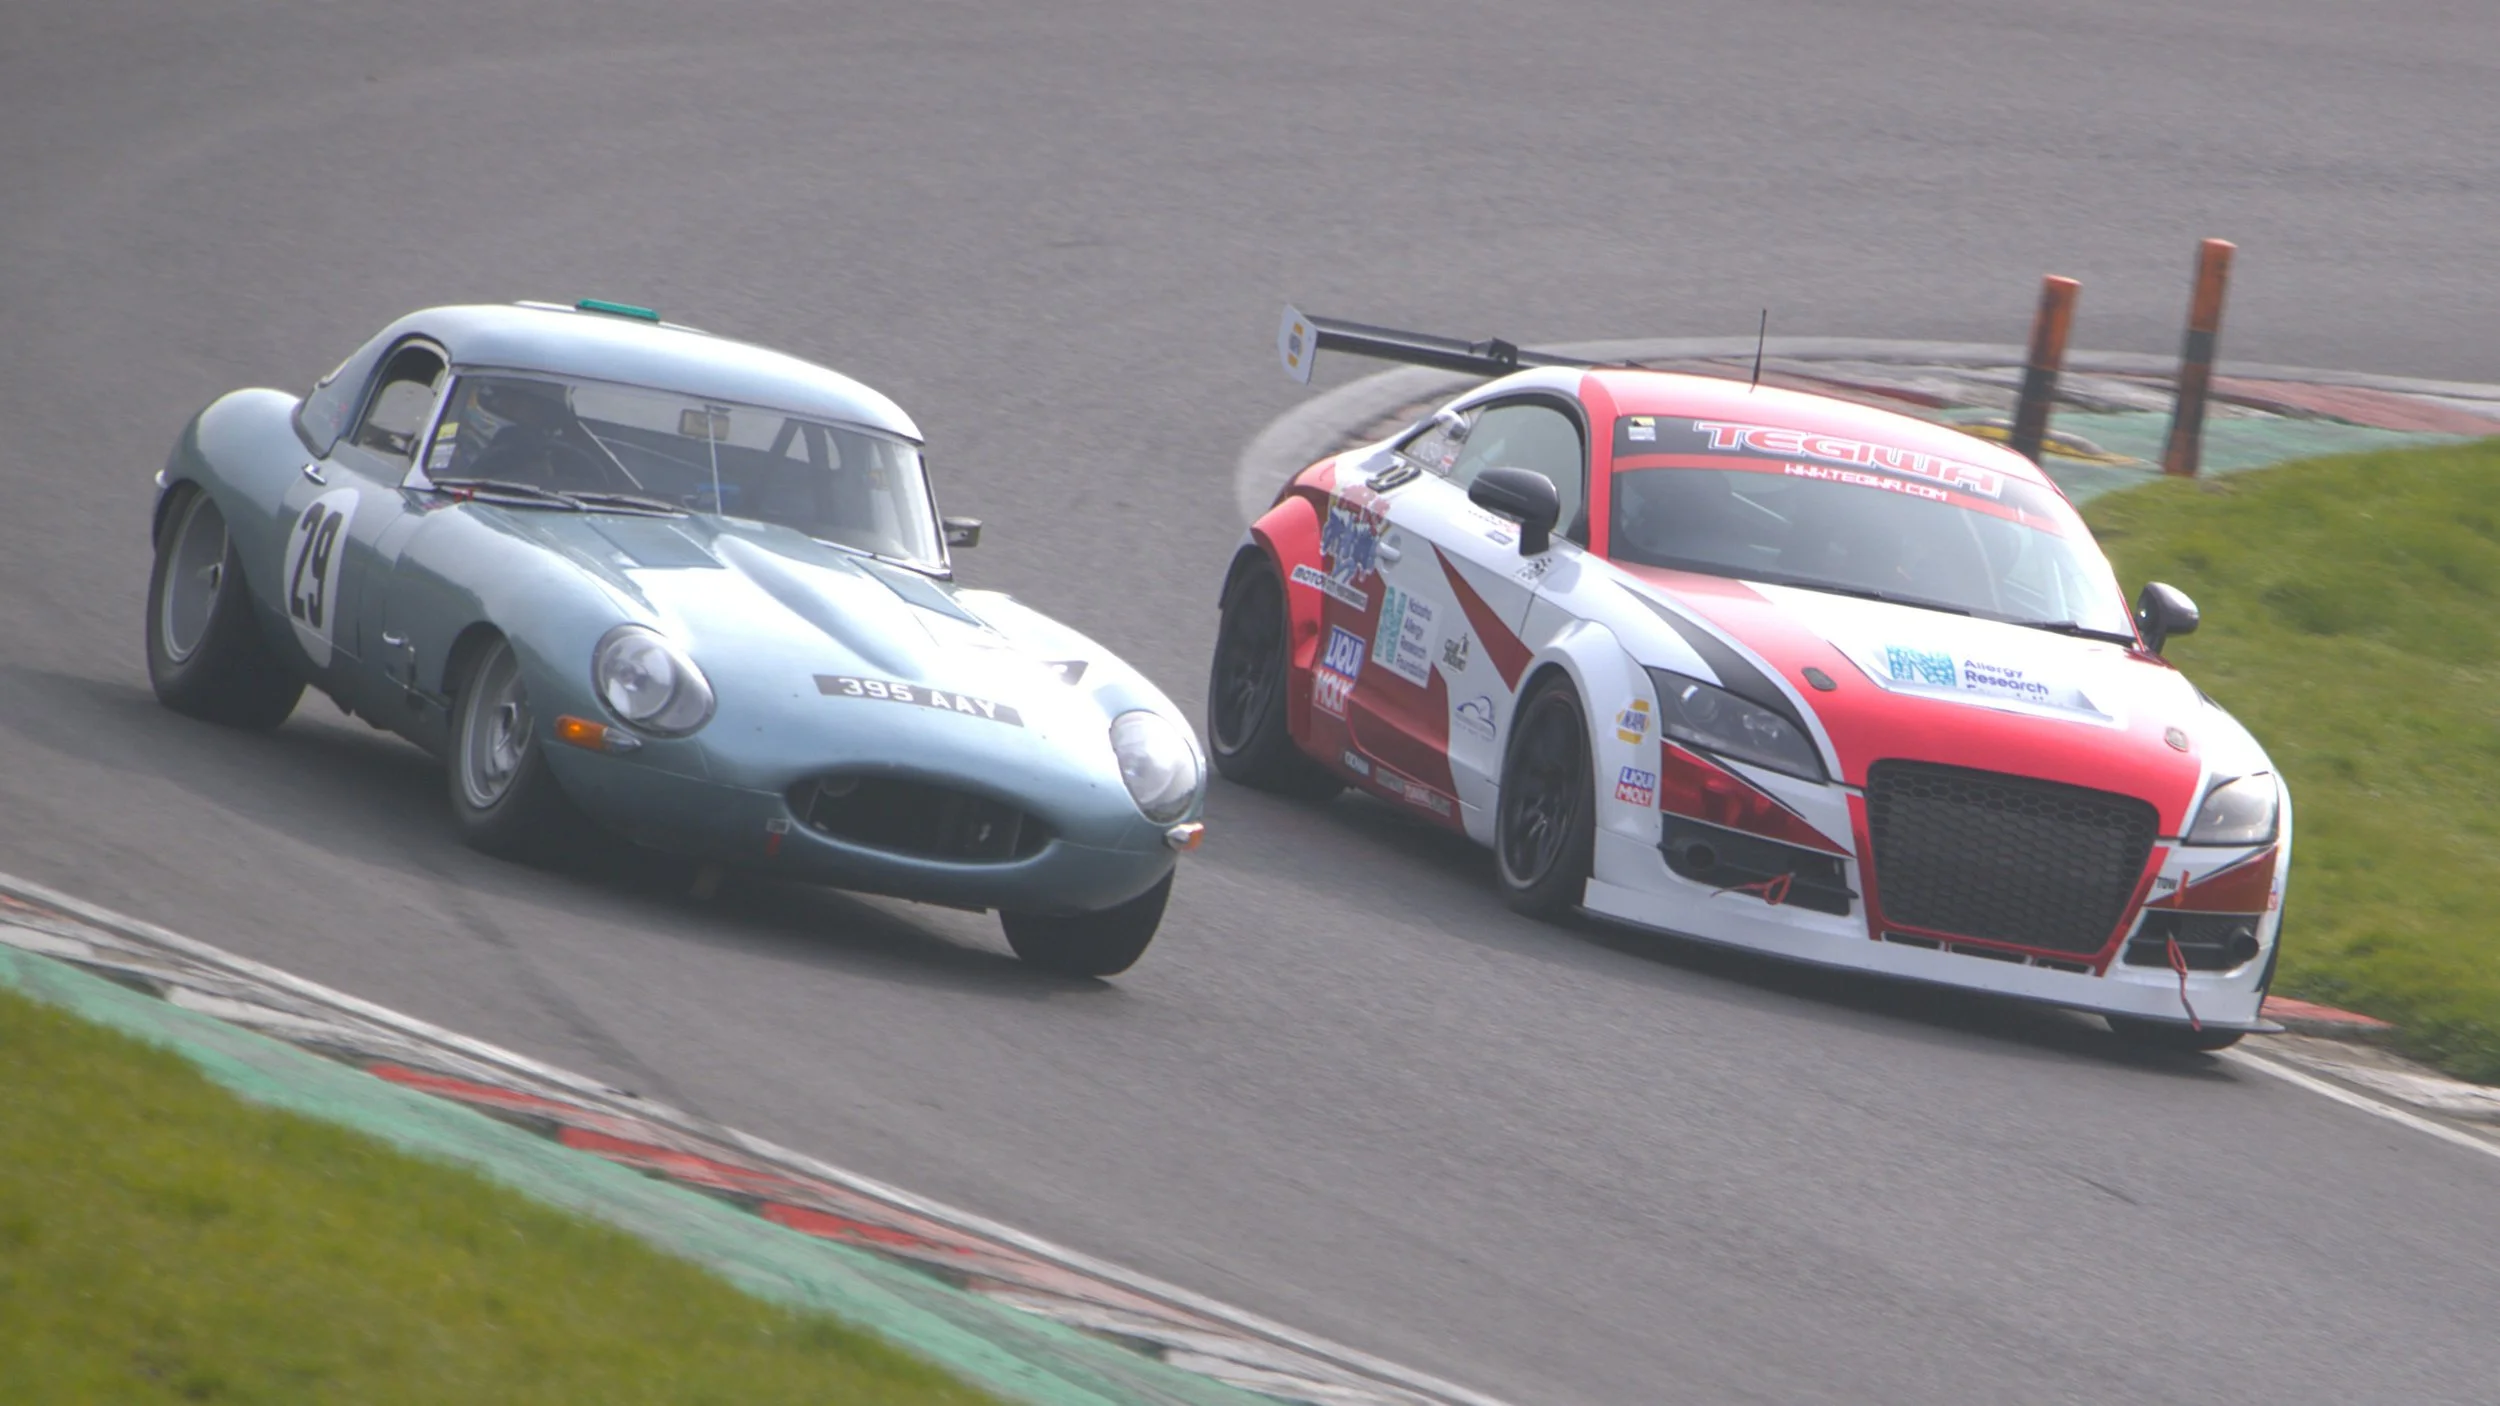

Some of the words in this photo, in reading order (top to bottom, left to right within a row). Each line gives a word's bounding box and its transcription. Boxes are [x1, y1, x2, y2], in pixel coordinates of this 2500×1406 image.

[1693, 420, 2002, 499] TEGIWA
[1784, 463, 1948, 501] WWW.TEGIWA.COM
[290, 501, 344, 629] 29
[1325, 630, 1363, 677] LIQUI
[1963, 659, 2023, 680] Allergy
[838, 677, 914, 703] 395
[930, 690, 997, 719] AAY
[1315, 668, 1355, 713] MOLY
[1964, 669, 2049, 695] Research
[1617, 783, 1652, 805] MOLY
[1621, 767, 1655, 790] LIQUI
